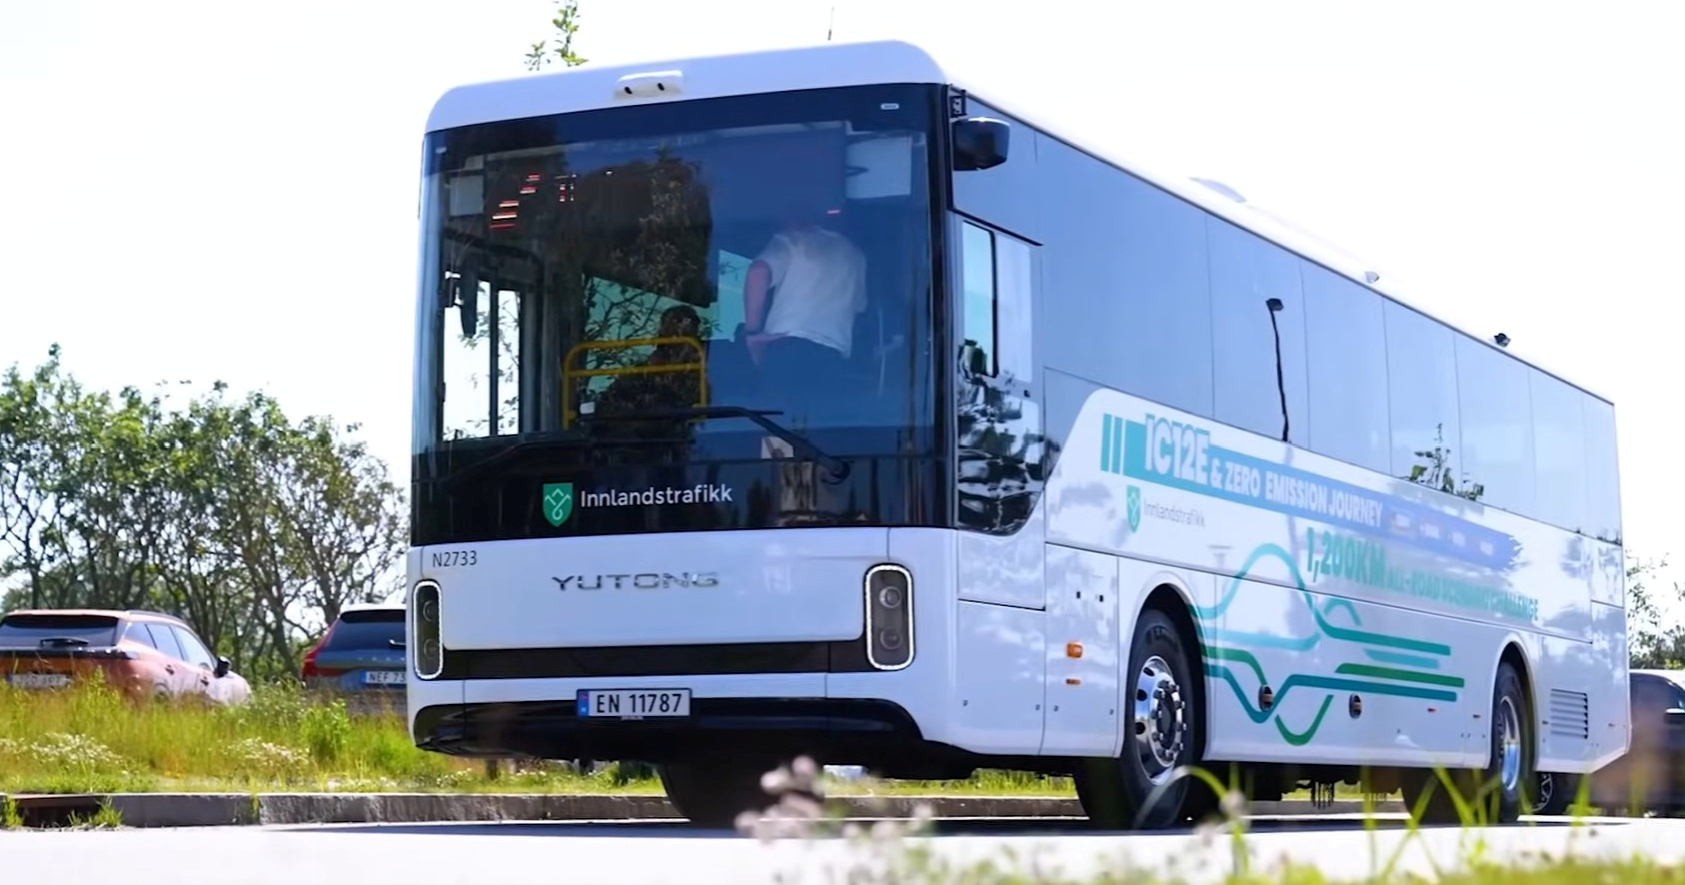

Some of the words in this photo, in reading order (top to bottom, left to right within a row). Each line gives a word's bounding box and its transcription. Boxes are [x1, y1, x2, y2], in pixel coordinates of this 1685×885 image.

[1145, 413, 1210, 485] IC12E
[1211, 458, 1223, 489] &
[1225, 461, 1261, 498] ZERO
[1265, 470, 1329, 515] EMISSION
[1328, 488, 1383, 527] JOURNEY
[581, 485, 732, 507] Innlandstrafikk
[1143, 497, 1207, 528] Innlandstrafikk
[432, 550, 478, 567] N2733
[1306, 527, 1386, 588] 1,200KM
[552, 572, 719, 591] YUTONG
[368, 672, 389, 682] NEF
[596, 694, 619, 713] EN
[629, 693, 682, 713] 11787
